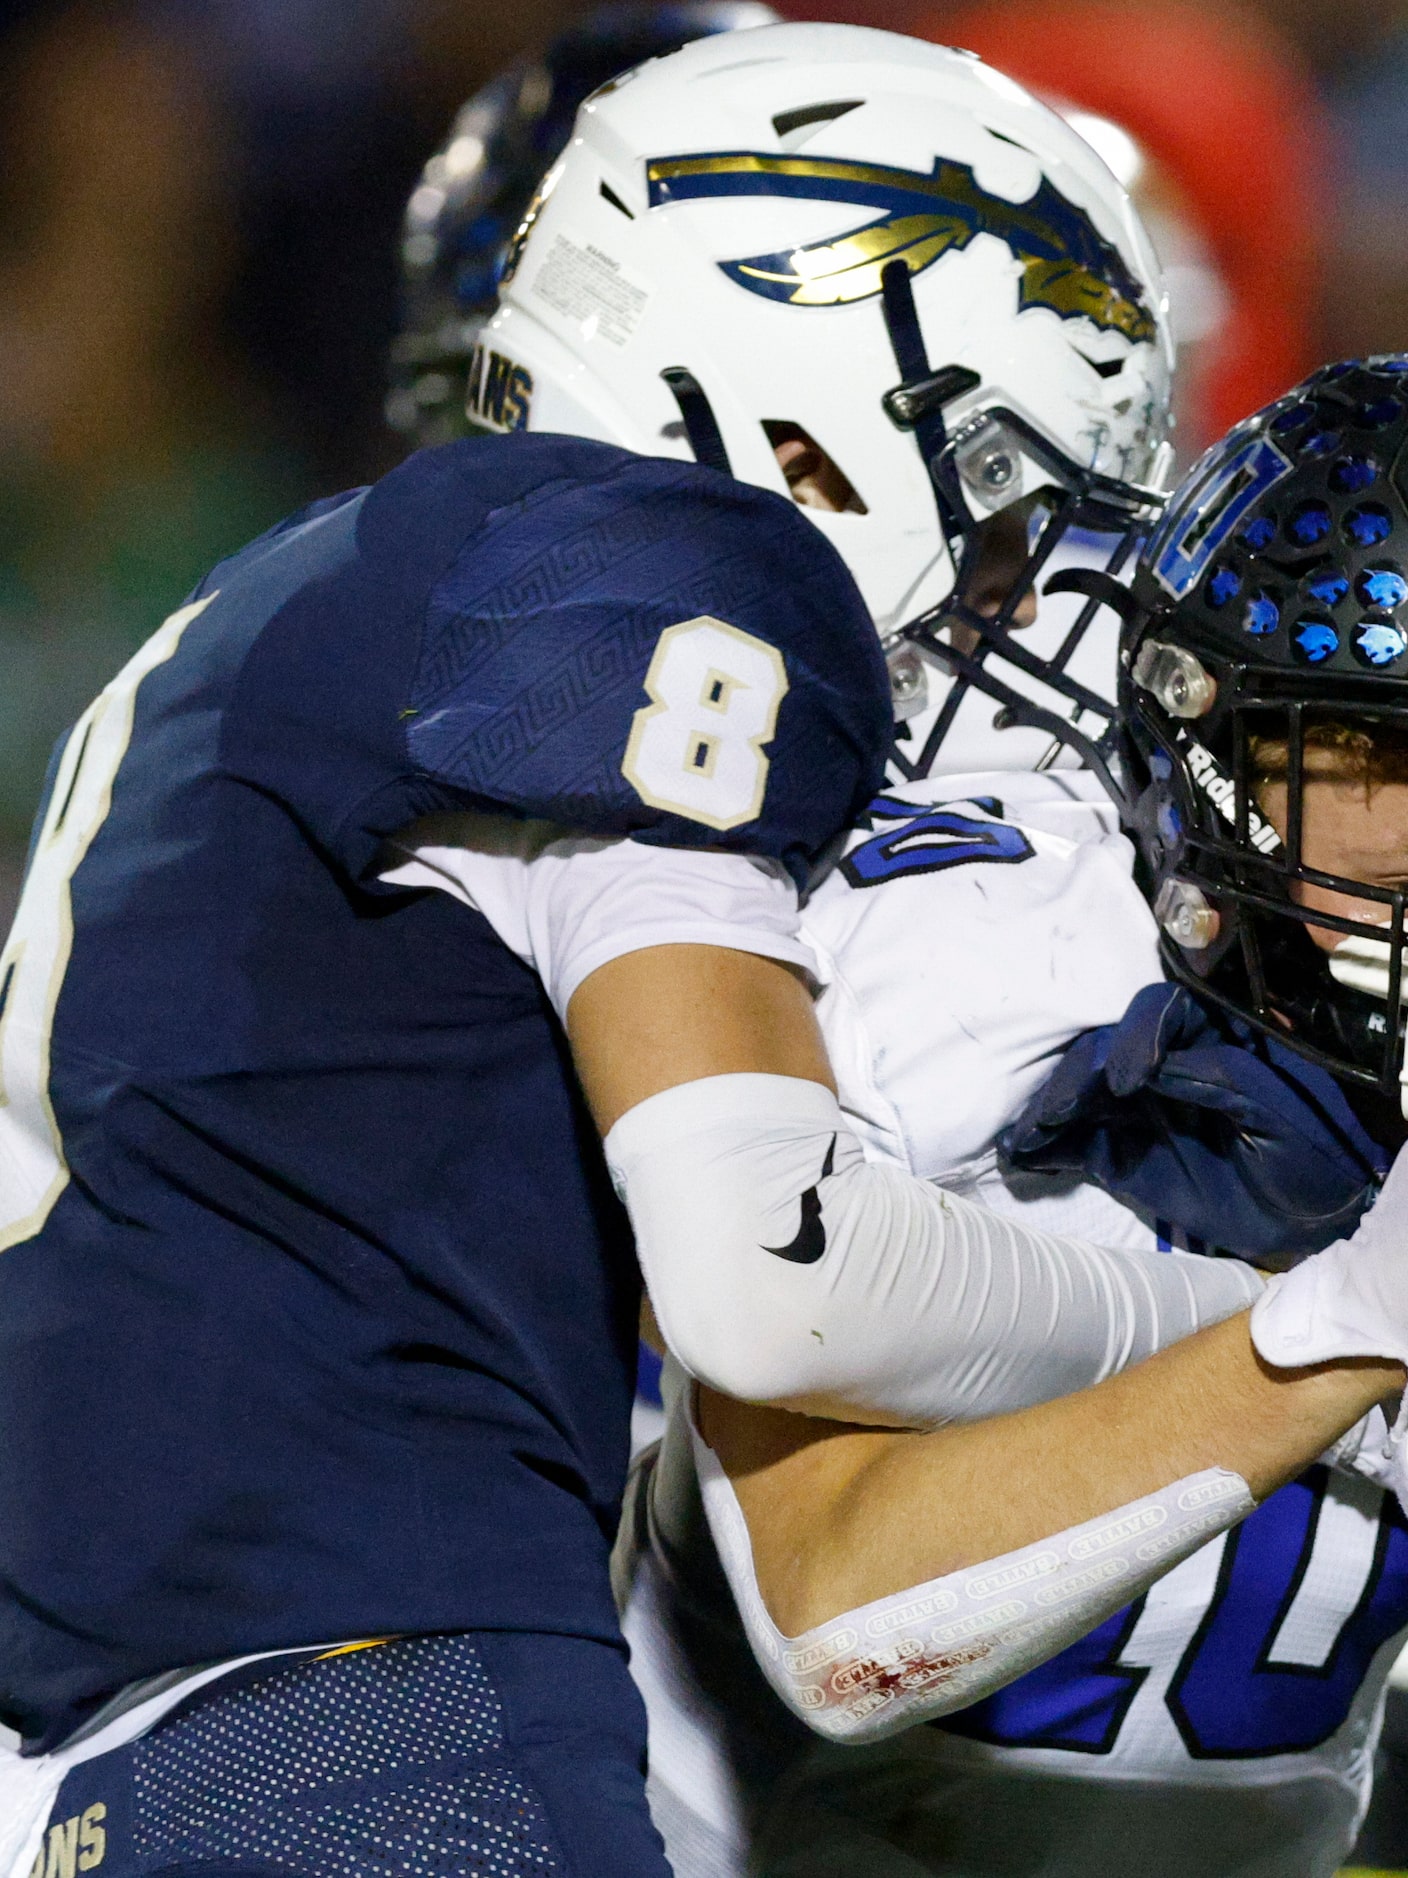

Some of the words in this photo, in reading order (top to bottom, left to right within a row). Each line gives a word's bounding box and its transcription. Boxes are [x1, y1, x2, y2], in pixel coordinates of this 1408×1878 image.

[621, 615, 788, 831] 8
[873, 1595, 950, 1633] BATTLE
[28, 1802, 107, 1878] NS
